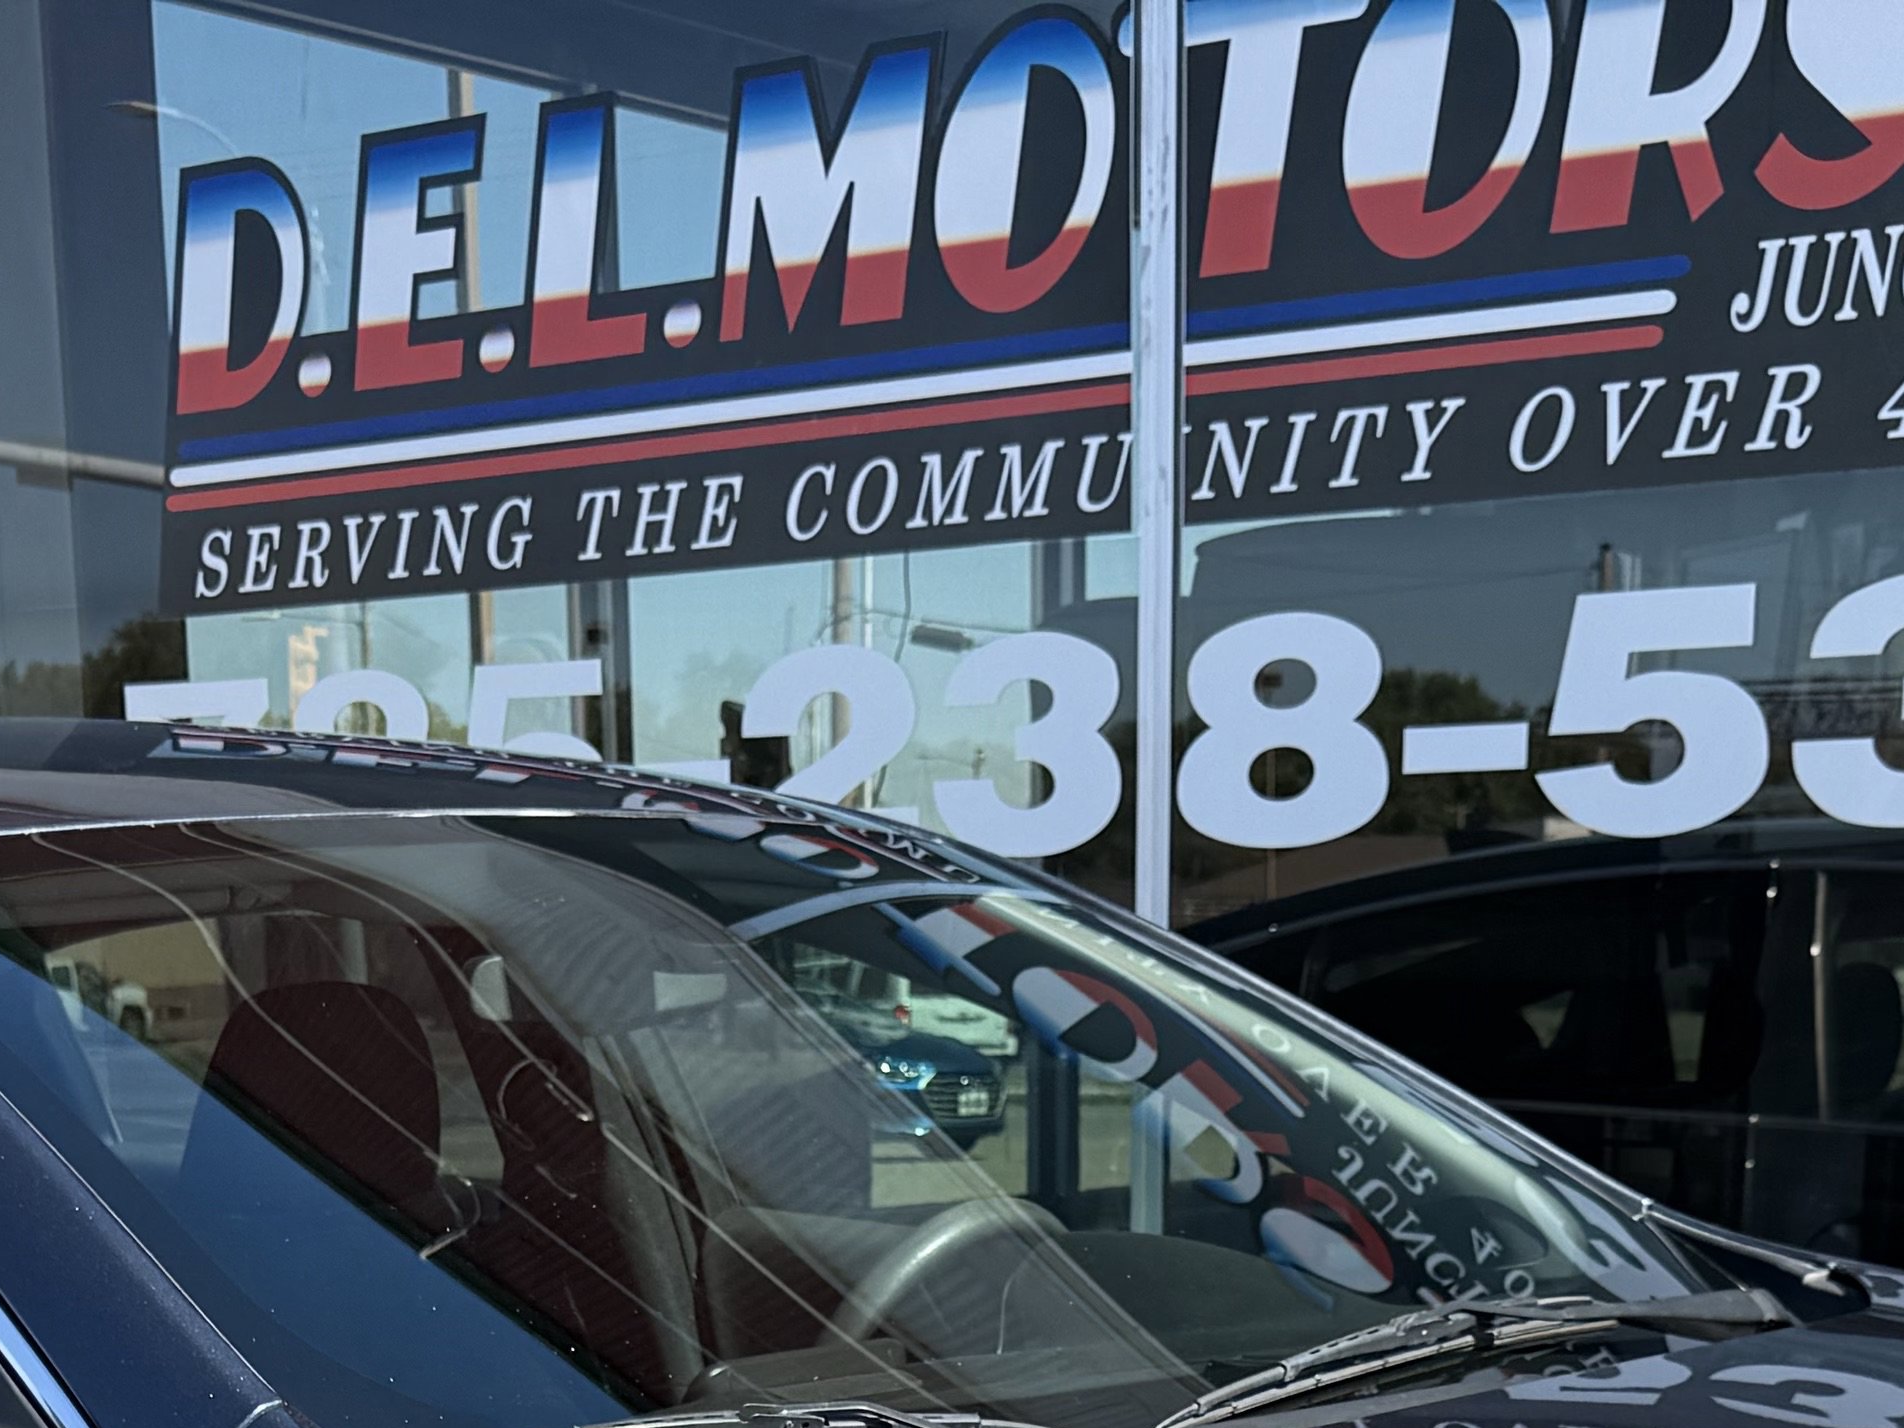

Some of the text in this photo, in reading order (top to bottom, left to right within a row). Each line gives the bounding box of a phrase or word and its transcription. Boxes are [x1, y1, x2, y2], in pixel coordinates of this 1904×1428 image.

[196, 495, 533, 599] SERVING
[576, 475, 743, 560] THE
[785, 396, 1466, 542] COMMUNITY
[1508, 363, 1823, 474] OVER
